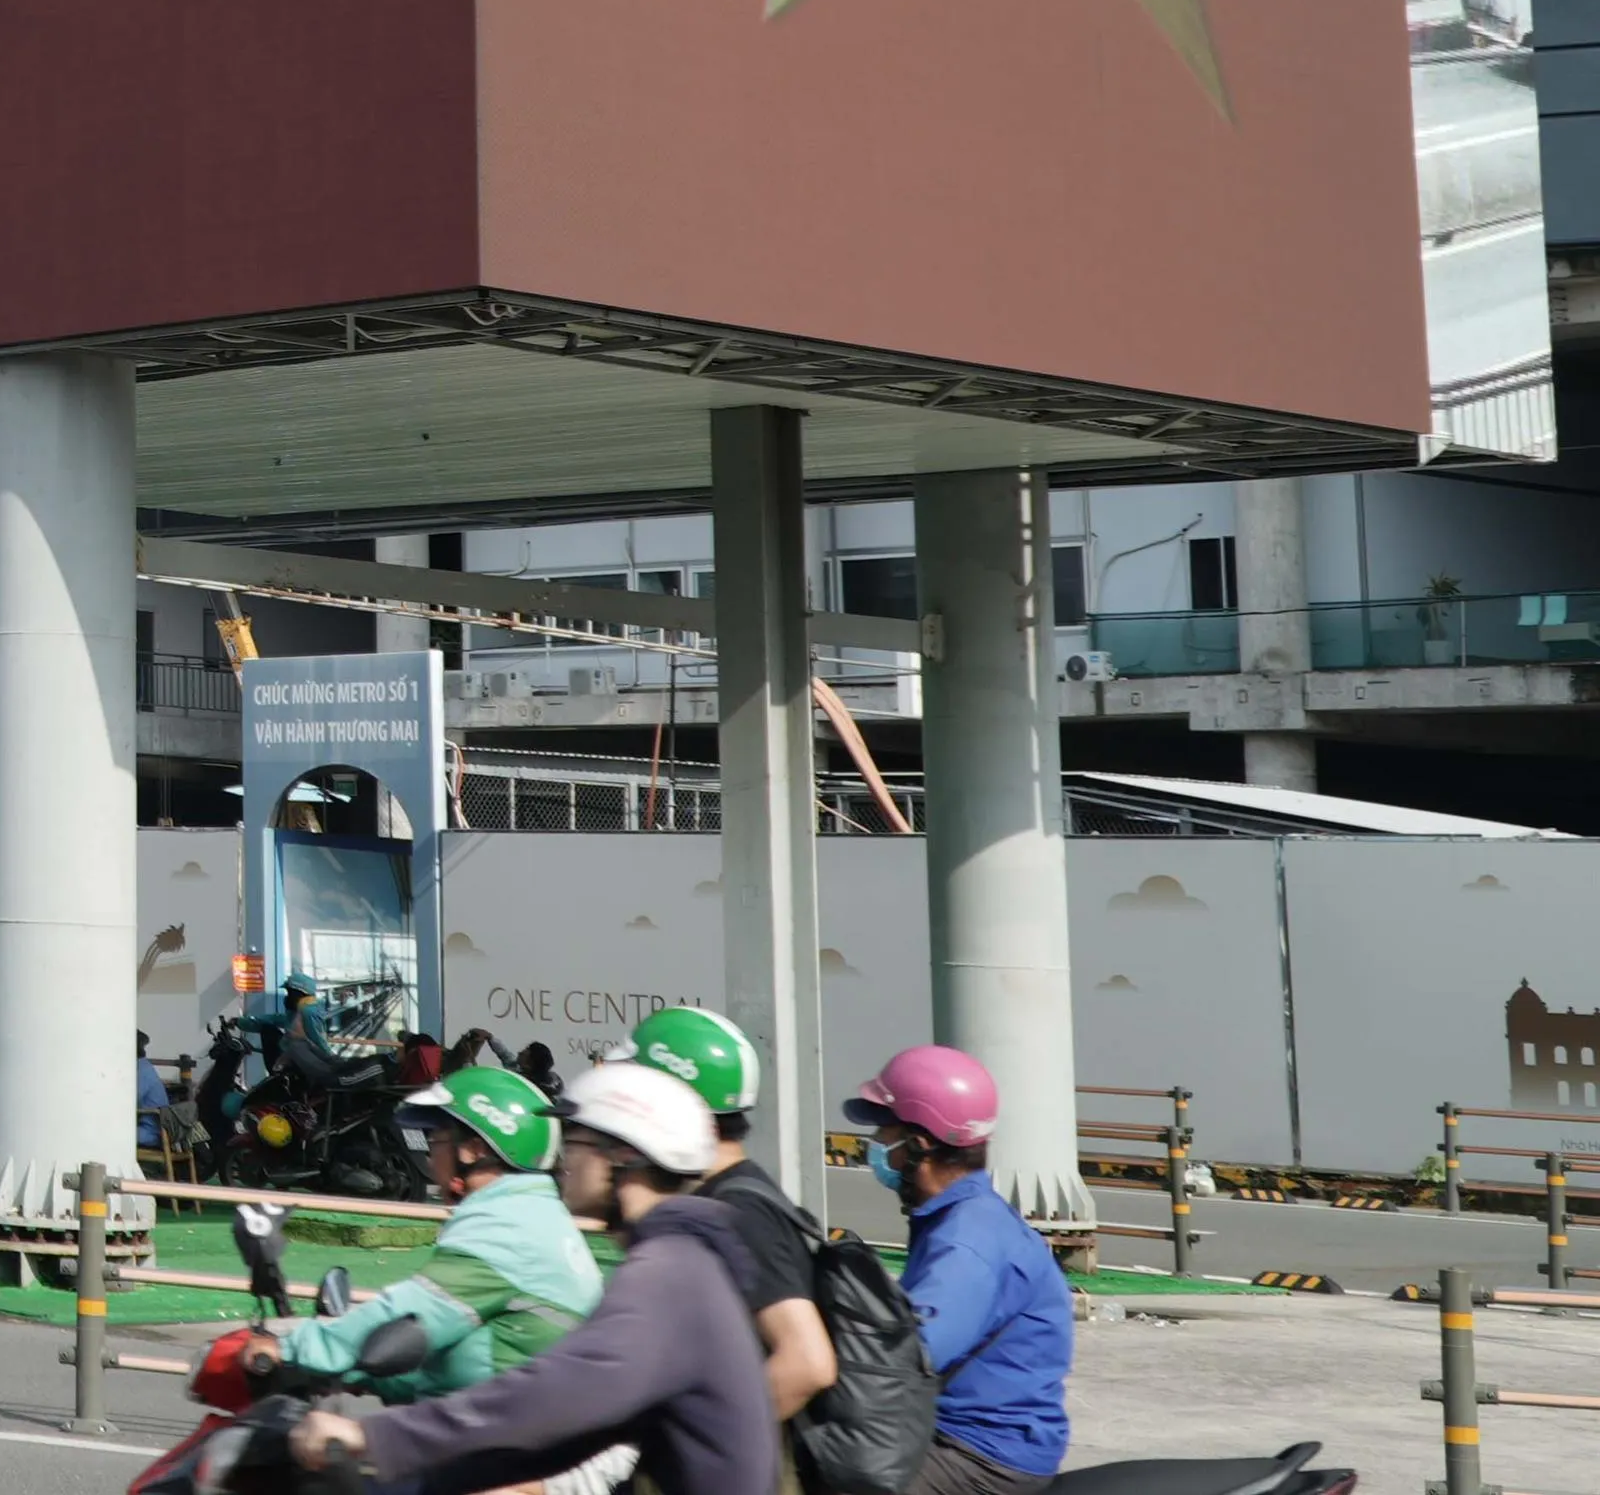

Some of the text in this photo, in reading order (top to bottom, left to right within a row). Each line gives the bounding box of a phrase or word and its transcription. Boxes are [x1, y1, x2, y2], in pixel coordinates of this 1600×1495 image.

[254, 673, 419, 705] CHÚC MỪNG METRO SỐ 1
[255, 716, 419, 749] VẬN HÀNH THƯƠNG MẠI
[487, 987, 701, 1025] ONE CENTR
[649, 1041, 700, 1081] Grab
[467, 1092, 519, 1136] Grab
